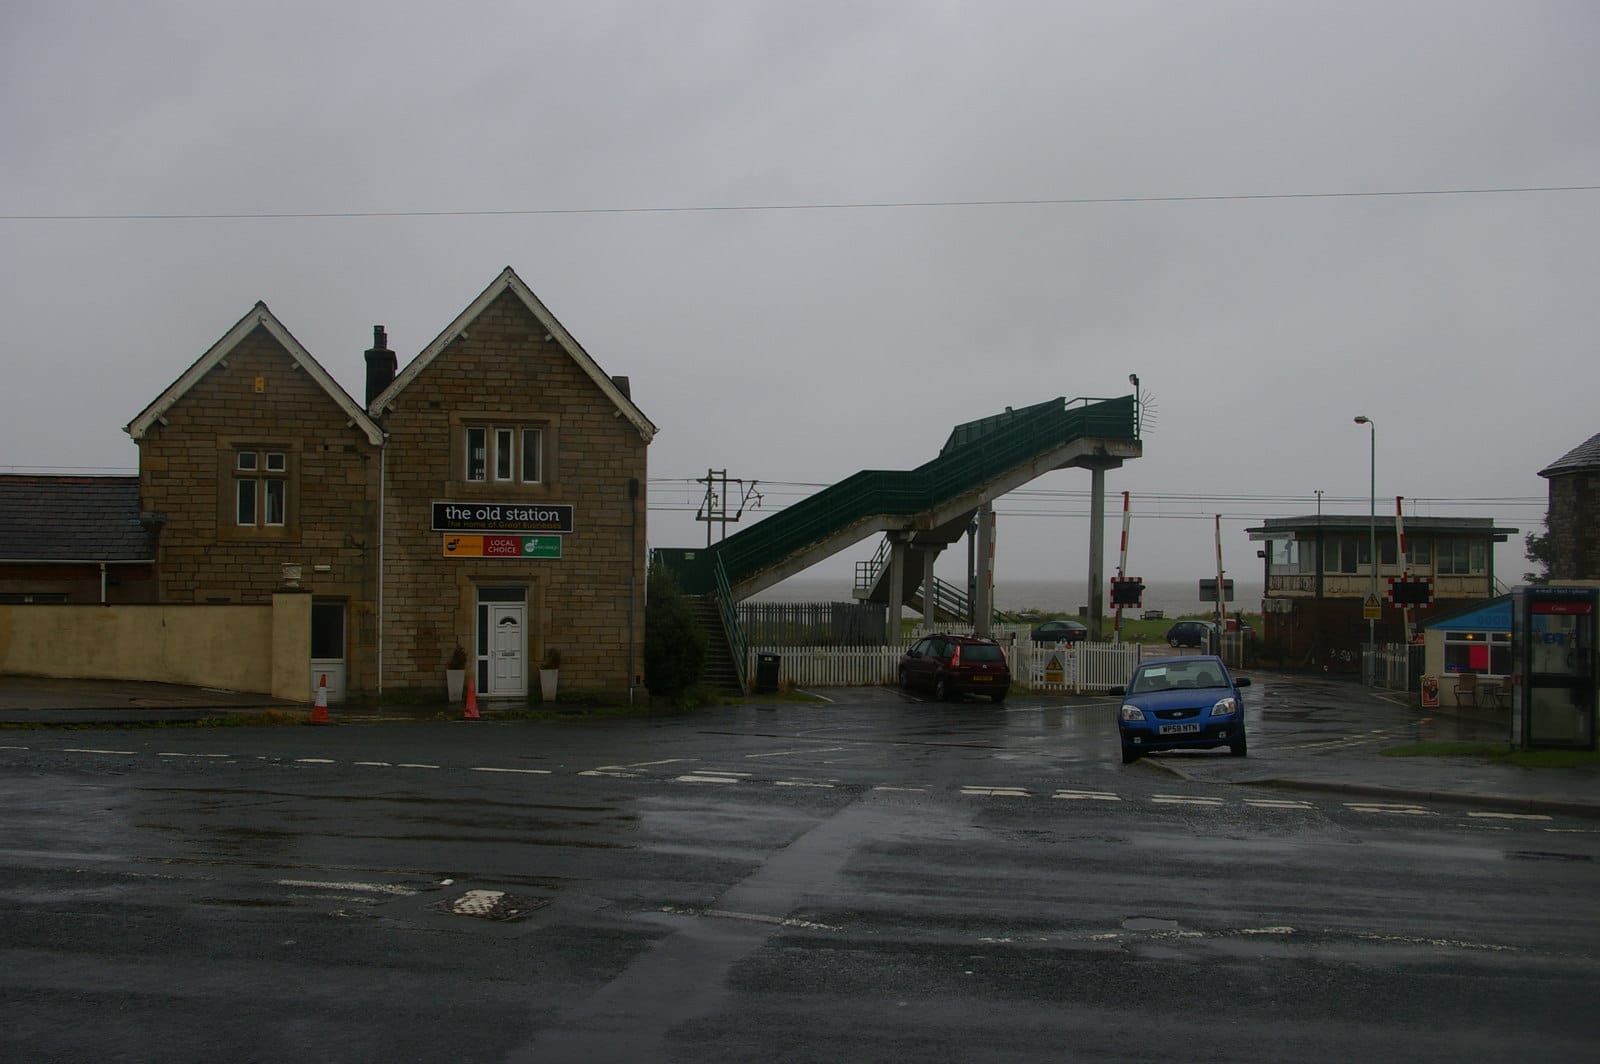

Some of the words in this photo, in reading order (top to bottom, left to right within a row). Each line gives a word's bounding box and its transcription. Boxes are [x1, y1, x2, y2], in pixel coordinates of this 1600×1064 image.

[445, 506, 471, 520] the
[476, 507, 501, 521] old
[506, 507, 560, 522] station
[490, 539, 515, 547] LOCAL
[487, 546, 517, 554] CHOICE
